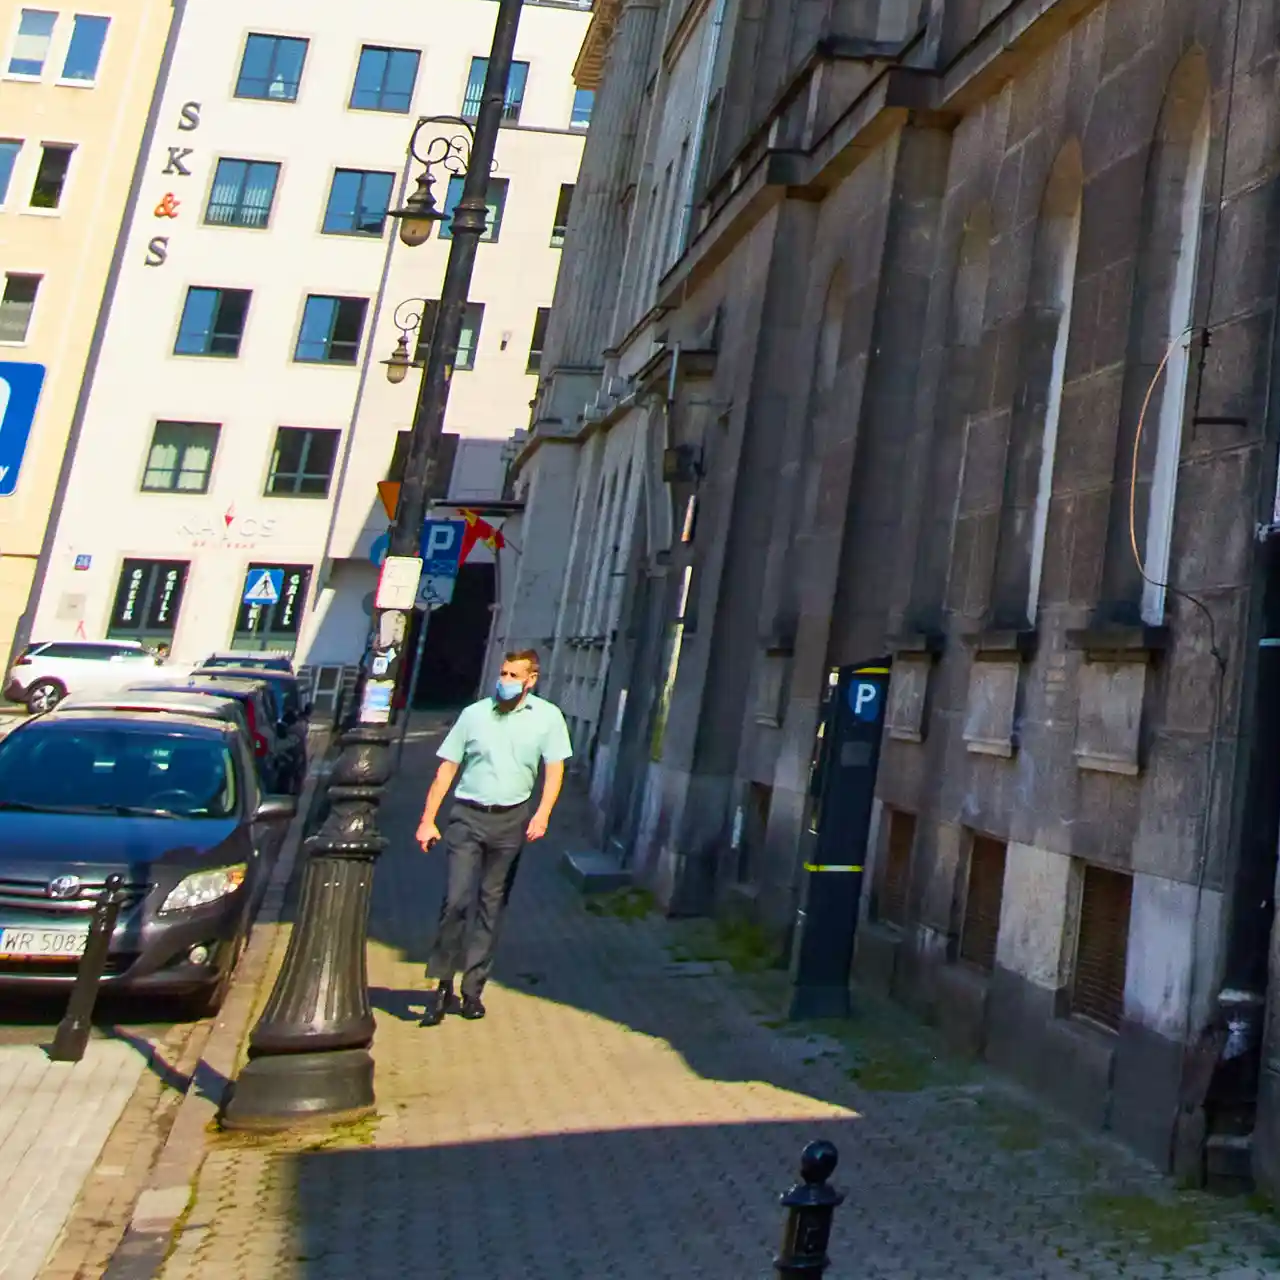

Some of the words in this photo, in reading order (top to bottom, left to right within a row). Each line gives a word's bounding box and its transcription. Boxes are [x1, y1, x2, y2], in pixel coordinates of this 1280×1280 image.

[424, 524, 456, 560] P
[853, 682, 876, 715] P
[5, 932, 34, 951] WR
